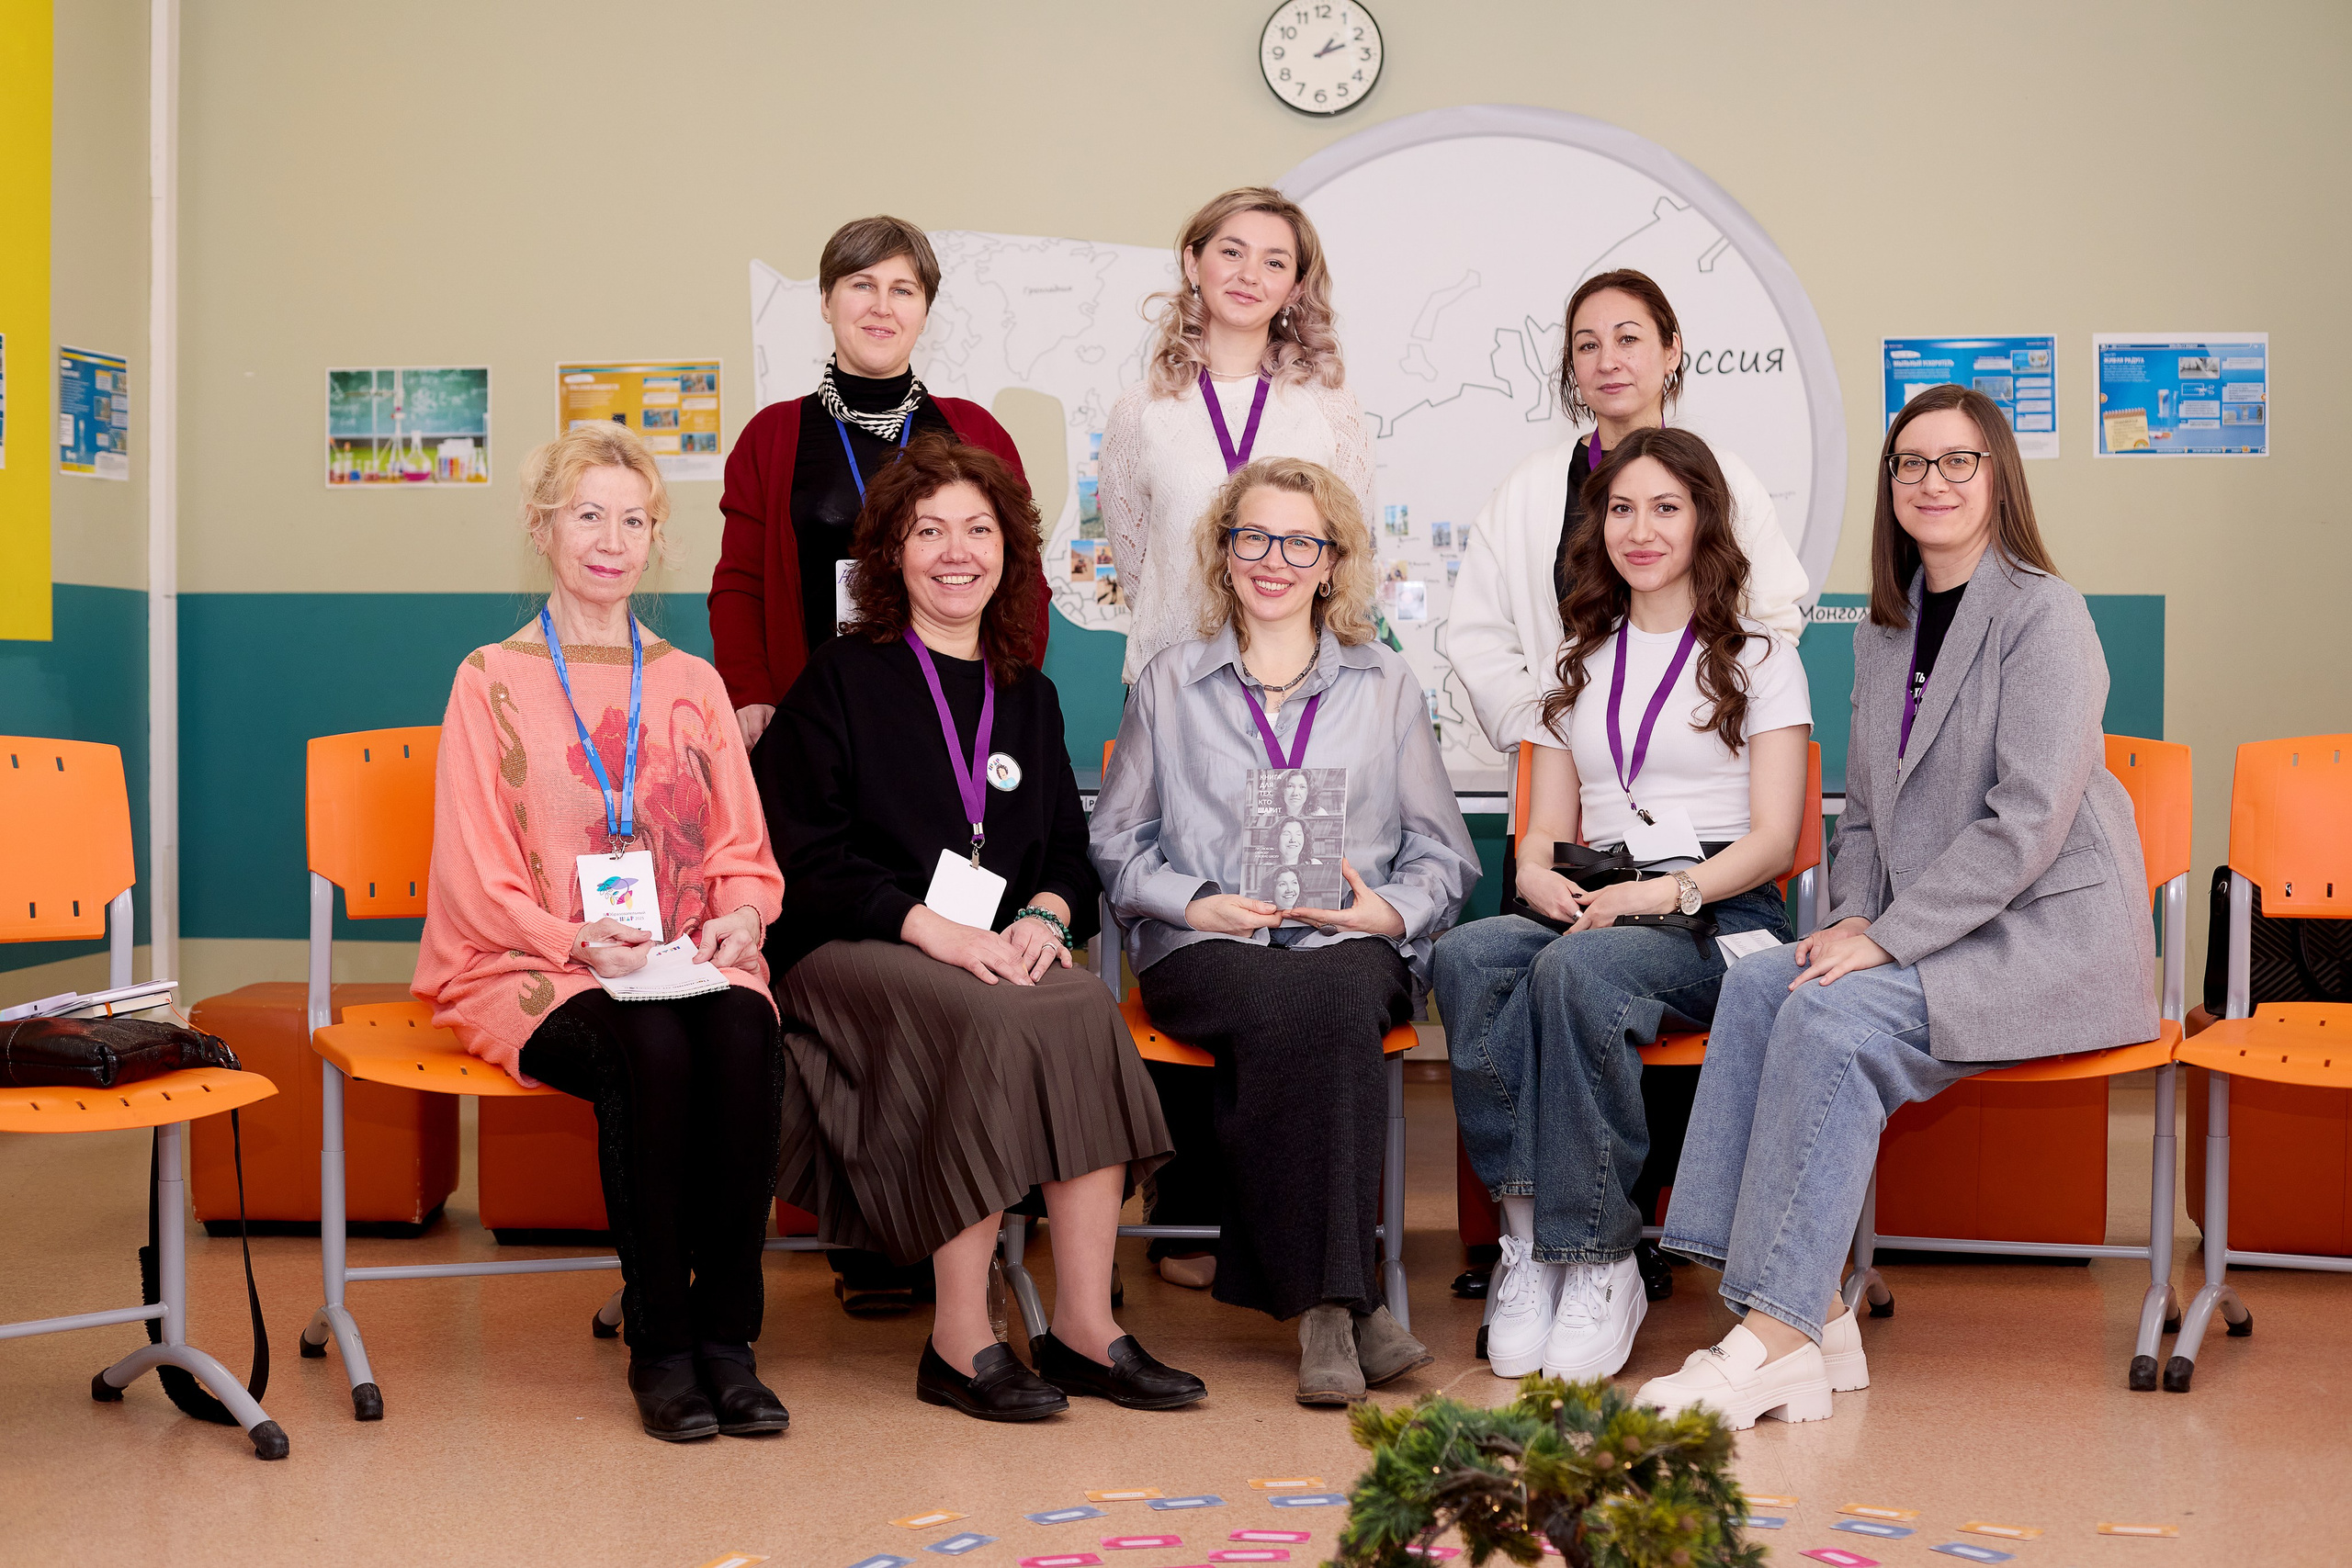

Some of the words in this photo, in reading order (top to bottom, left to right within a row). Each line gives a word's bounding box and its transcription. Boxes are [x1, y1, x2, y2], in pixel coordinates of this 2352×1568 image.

[1314, 5, 1331, 18] 12
[1296, 12, 1308, 25] 11
[1341, 12, 1348, 25] 1
[1280, 26, 1297, 39] 10
[1353, 27, 1363, 40] 2
[1272, 46, 1285, 60] 9
[1360, 48, 1372, 61] 3
[1280, 68, 1291, 81] 8
[1352, 69, 1363, 82] 4
[1295, 83, 1306, 96] 7
[1314, 89, 1327, 103] 6
[1337, 83, 1349, 96] 5
[1682, 348, 1784, 375] оссия
[1799, 604, 1868, 621] Монгол
